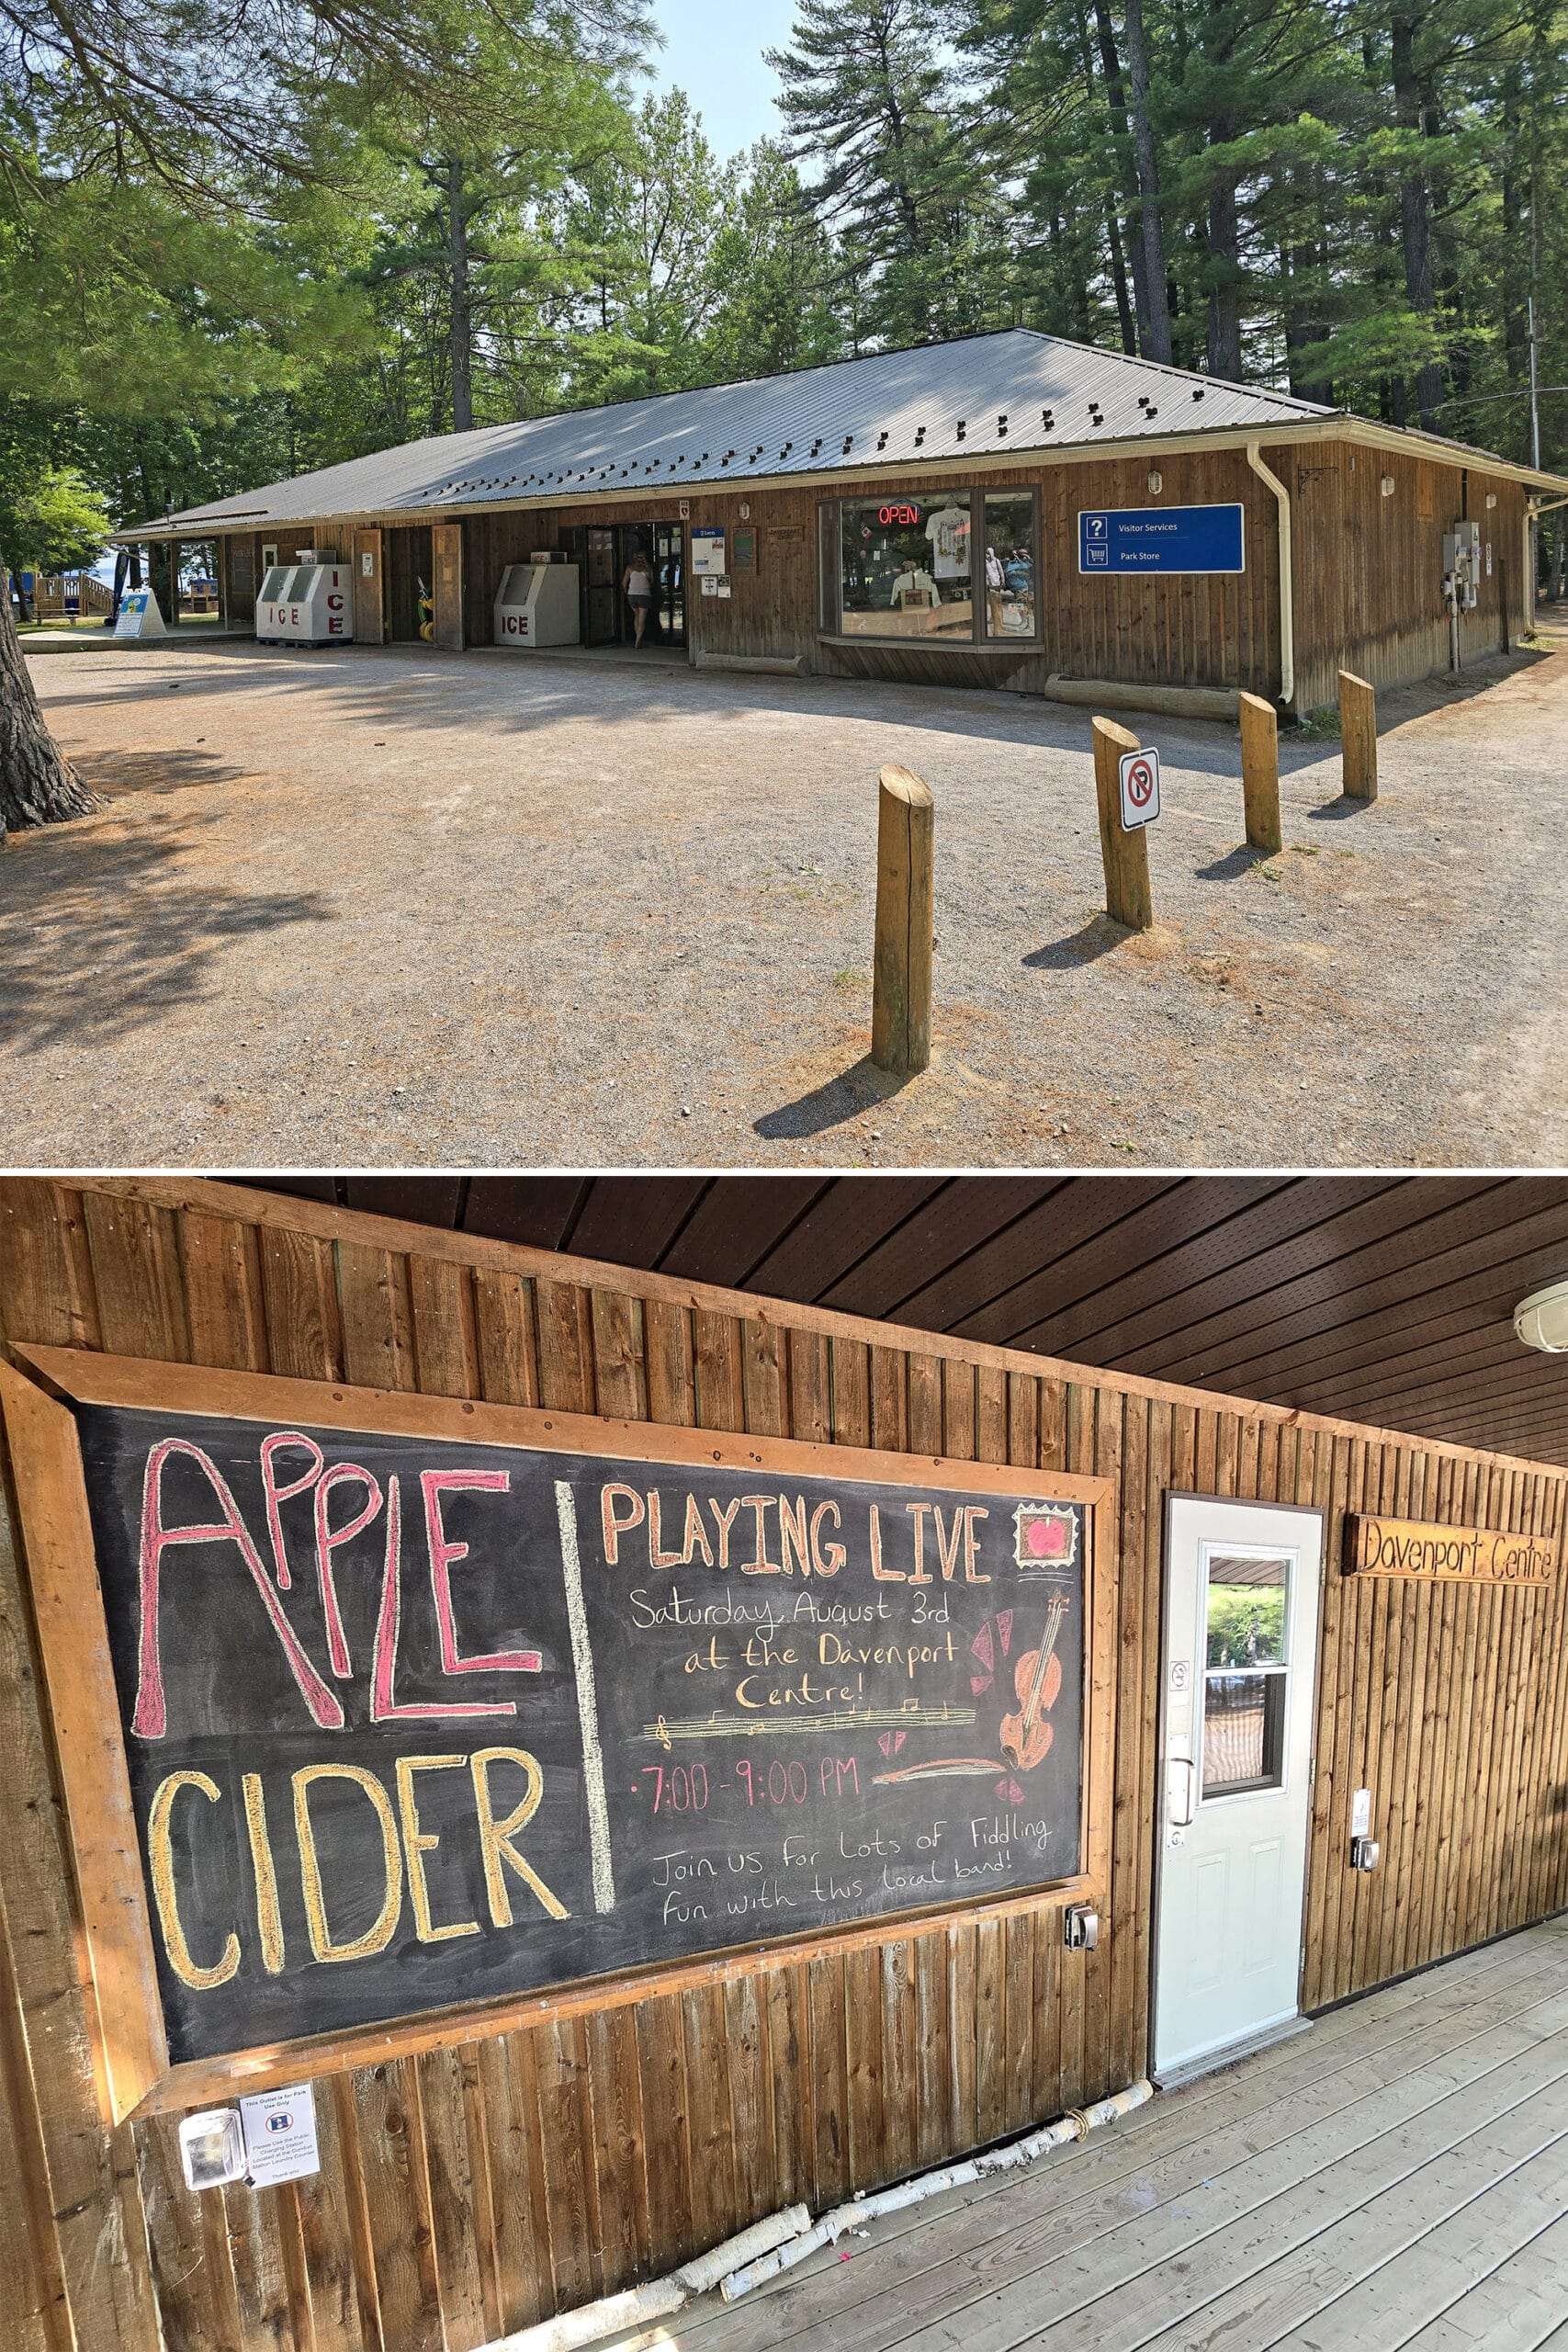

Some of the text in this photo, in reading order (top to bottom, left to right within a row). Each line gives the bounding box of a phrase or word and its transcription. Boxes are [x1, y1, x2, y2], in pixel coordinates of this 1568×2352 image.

[878, 506, 919, 525] OPEN
[1119, 523, 1178, 533] Visitor Services
[1121, 552, 1160, 560] Park Store
[269, 607, 299, 626] ICE
[327, 571, 344, 634] ICE
[502, 616, 529, 635] ICE
[601, 1482, 992, 1584] PLAYING LIVE
[1364, 1520, 1552, 1580] Davenport Centre
[130, 1430, 542, 1738] APPLE
[792, 1591, 891, 1625] August
[911, 1592, 950, 1624] 3rd
[684, 1632, 959, 1678] at the Davenport
[734, 1673, 863, 1708] Centre!
[819, 1757, 861, 1797] PM
[651, 1853, 717, 1887] Join
[970, 1812, 1055, 1850] Fiddling
[147, 1747, 572, 1991] CIDER
[727, 1882, 797, 1915] with
[810, 1876, 863, 1903] this
[883, 1859, 947, 1890] local
[953, 1849, 1013, 1880] band!
[260, 2096, 276, 2104] Outlet
[272, 2156, 293, 2165] Laundry
